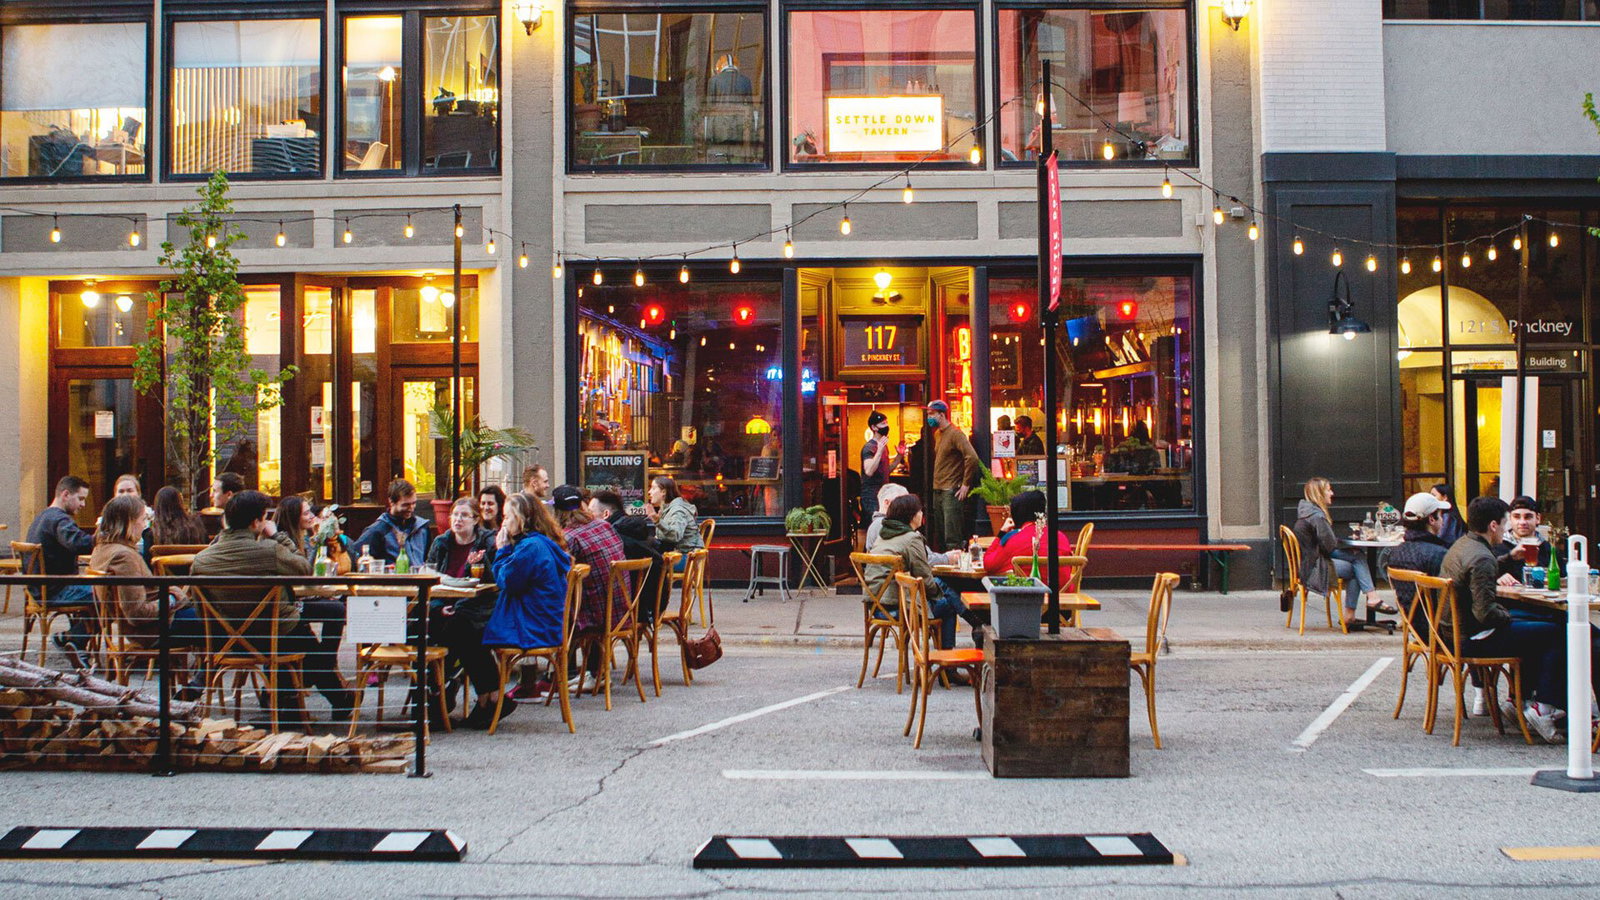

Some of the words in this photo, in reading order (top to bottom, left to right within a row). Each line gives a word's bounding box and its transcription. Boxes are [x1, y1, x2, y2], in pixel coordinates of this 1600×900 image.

[836, 115, 886, 124] SETTLE
[895, 115, 935, 124] DOWN
[863, 127, 908, 135] TAVERN
[1508, 319, 1573, 336] Pnckney
[864, 325, 897, 350] 117
[1529, 357, 1568, 368] Building
[958, 327, 972, 427] BAR
[587, 456, 642, 465] FEATURING
